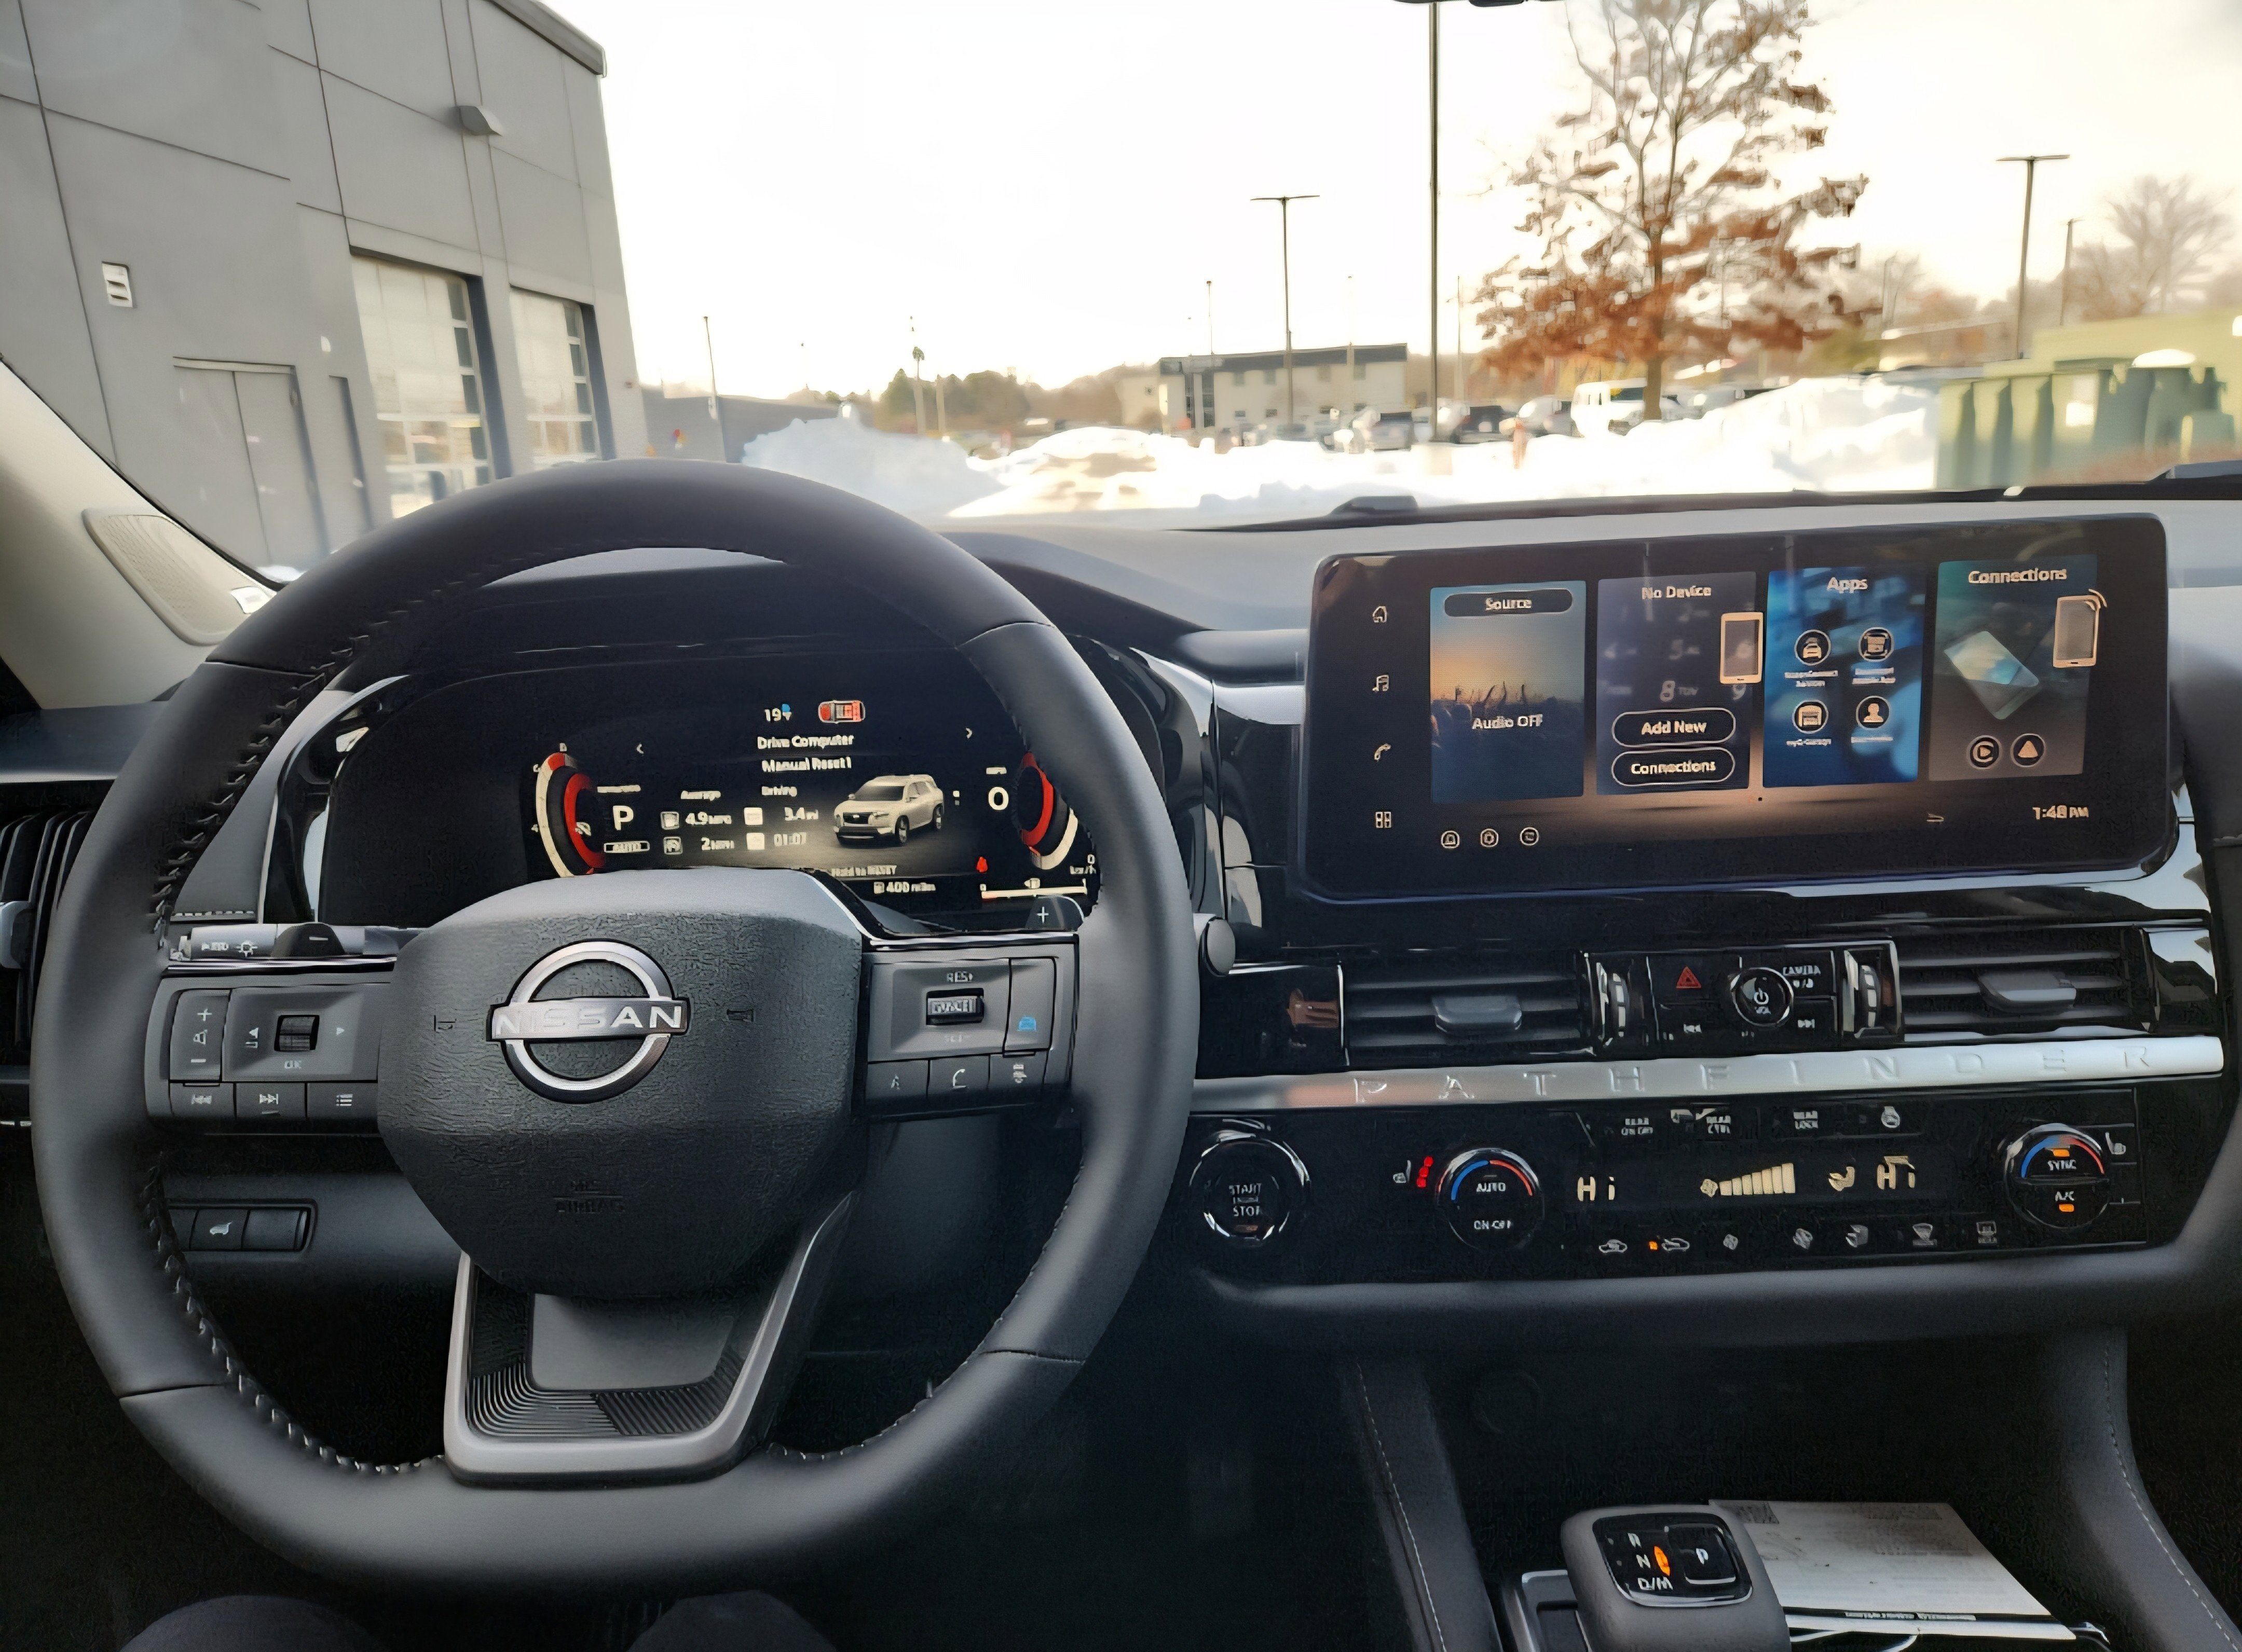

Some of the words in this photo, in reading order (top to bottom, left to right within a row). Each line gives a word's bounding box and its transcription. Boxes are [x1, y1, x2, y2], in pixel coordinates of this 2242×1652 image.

[1968, 567, 2067, 584] Connections
[1642, 587, 1662, 600] No
[1666, 585, 1712, 598] Device
[1827, 576, 1868, 594] Apps
[1485, 598, 1532, 611] Source
[1472, 715, 1514, 729] Audio
[1517, 713, 1543, 727] OFF
[1641, 720, 1672, 735] Add
[1674, 720, 1707, 733] New
[1631, 760, 1716, 775] Connections
[988, 786, 1009, 810] 0
[612, 805, 634, 831] P
[1353, 1045, 2151, 1104] PATHFINDER
[2047, 1159, 2076, 1171] SYNC
[1476, 1182, 1506, 1192] AUTO
[1577, 1176, 1615, 1202] Hi
[1636, 1554, 1651, 1569] N
[1696, 1548, 1709, 1565] P
[1637, 1576, 1673, 1591] D/M
